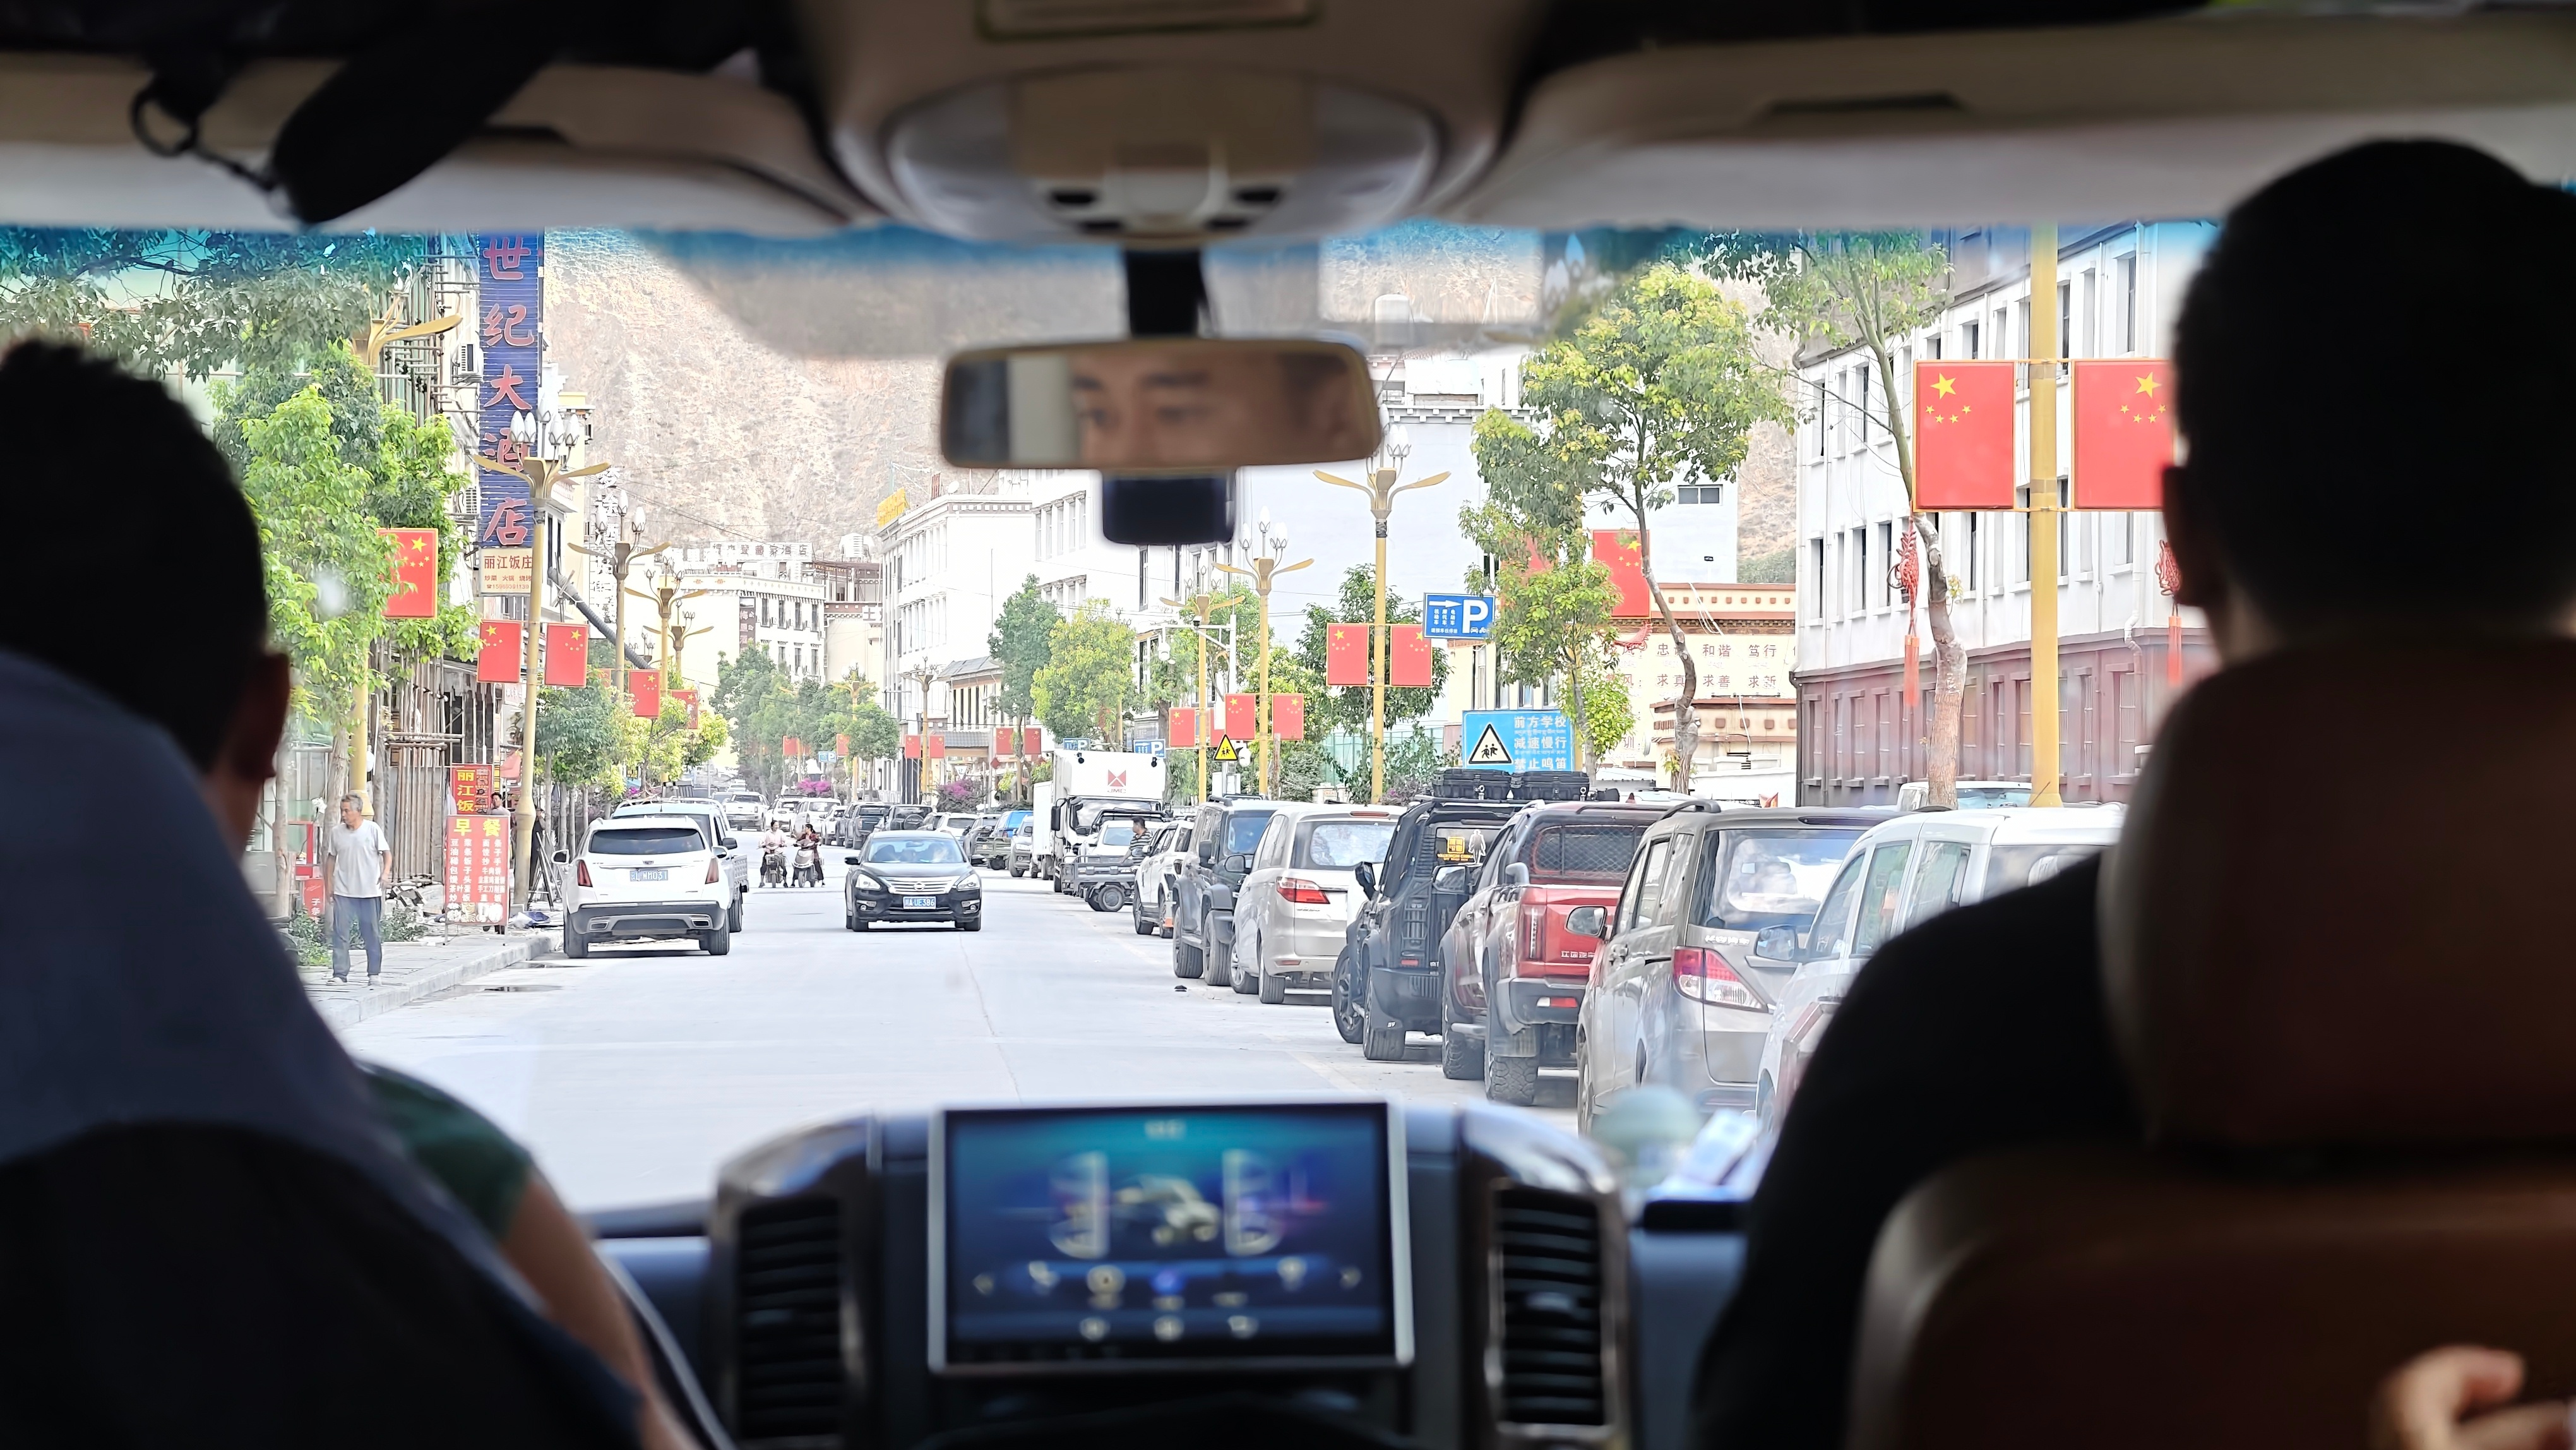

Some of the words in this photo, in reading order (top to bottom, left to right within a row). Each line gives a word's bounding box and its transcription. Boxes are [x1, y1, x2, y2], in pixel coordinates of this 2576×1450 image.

[482, 235, 534, 546] 世纪大酒店
[484, 555, 532, 569] 丽江饭庄
[1462, 599, 1489, 633] P
[1702, 644, 1731, 657] 和谐
[1748, 644, 1777, 657] 笃行
[1657, 673, 1685, 687] 求真
[1703, 674, 1731, 687] 求善
[1514, 716, 1567, 728] 前方学校
[1151, 741, 1164, 757] P
[1514, 736, 1567, 750] 减速慢行
[1514, 757, 1567, 770] 禁止鸣笛
[453, 818, 501, 837] 早餐
